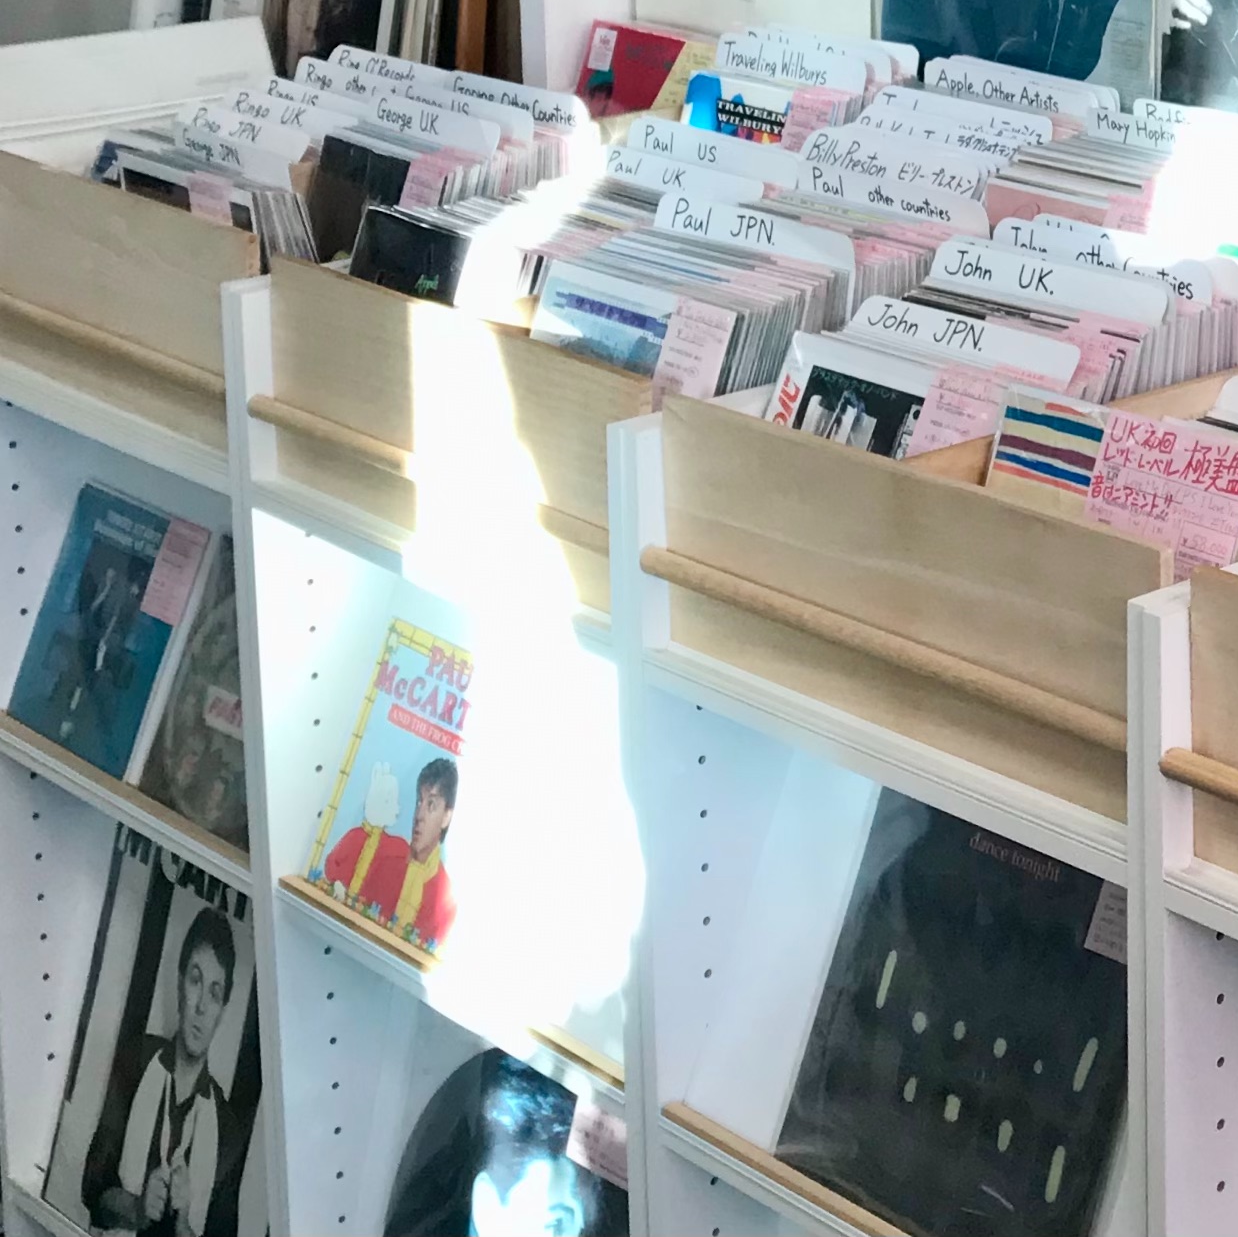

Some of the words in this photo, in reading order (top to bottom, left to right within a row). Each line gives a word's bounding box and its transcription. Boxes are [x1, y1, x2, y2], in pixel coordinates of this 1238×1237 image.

[305, 63, 333, 89] Ringo
[723, 40, 777, 78] Traveling
[779, 51, 828, 86] Wilburys
[232, 91, 271, 119] Ringo
[377, 97, 413, 132] George
[418, 112, 440, 136] UK
[716, 98, 787, 125] TRAVELIN
[983, 79, 1016, 104] Other
[1019, 88, 1060, 114] Artists
[643, 124, 674, 156] Paul
[697, 143, 718, 164] US
[716, 112, 785, 136] WILBURY
[1097, 112, 1131, 145] Mary
[1135, 119, 1177, 151] Hopkin
[606, 149, 642, 178] Paul
[805, 132, 844, 170] Billy
[841, 140, 887, 179] Preston
[812, 166, 846, 200] Paul
[868, 185, 896, 210] other
[900, 195, 952, 223] countries
[672, 197, 714, 236] Paul
[729, 214, 776, 247] JPN.
[944, 249, 993, 283] John
[1018, 262, 1055, 297] UK.
[868, 303, 919, 338] John
[933, 317, 983, 352] JPN.
[425, 644, 475, 693] PAU
[374, 659, 473, 732] McCART
[968, 831, 1010, 863] dance
[1011, 847, 1062, 883] tonight
